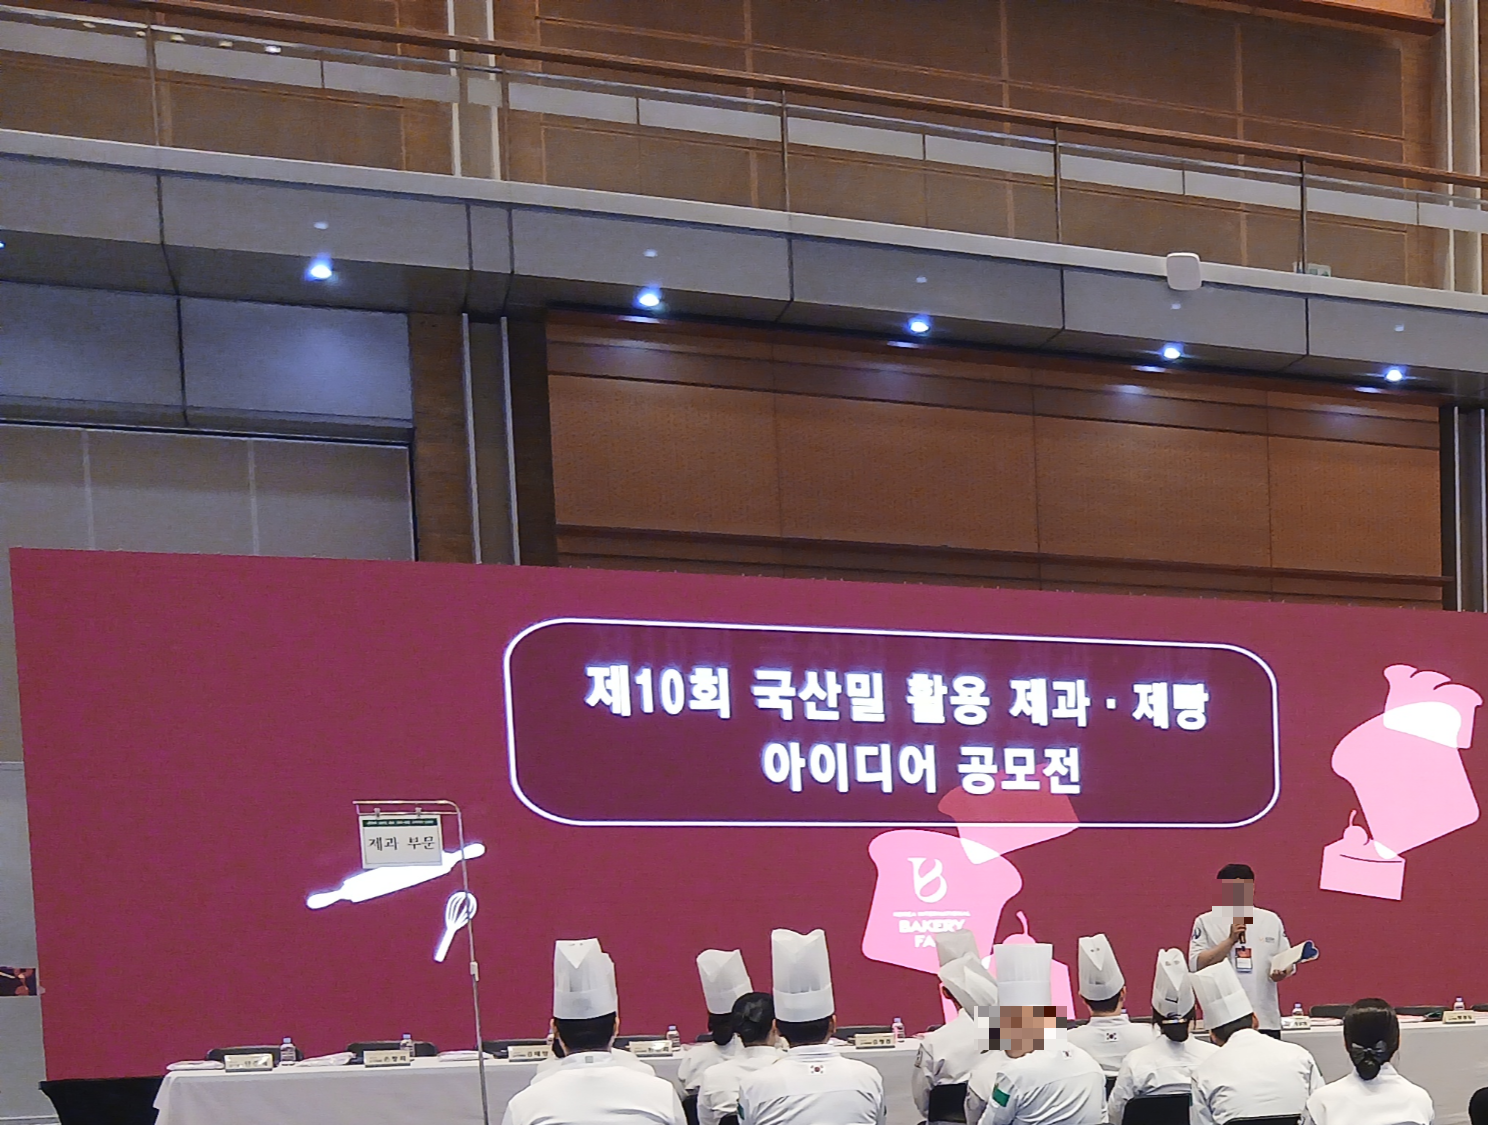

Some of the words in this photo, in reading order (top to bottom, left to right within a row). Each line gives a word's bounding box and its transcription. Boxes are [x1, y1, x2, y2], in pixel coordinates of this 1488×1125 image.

[585, 664, 731, 719] 제10회
[751, 668, 886, 723] 국산밀
[906, 672, 992, 726] 활용
[1009, 677, 1091, 728] 제과
[1131, 681, 1210, 731] 제빵
[761, 740, 938, 794] 아이디어
[957, 745, 1082, 795] 공모전
[368, 836, 399, 852] 제과
[407, 836, 436, 850] 부문
[898, 918, 966, 934] BAKERY
